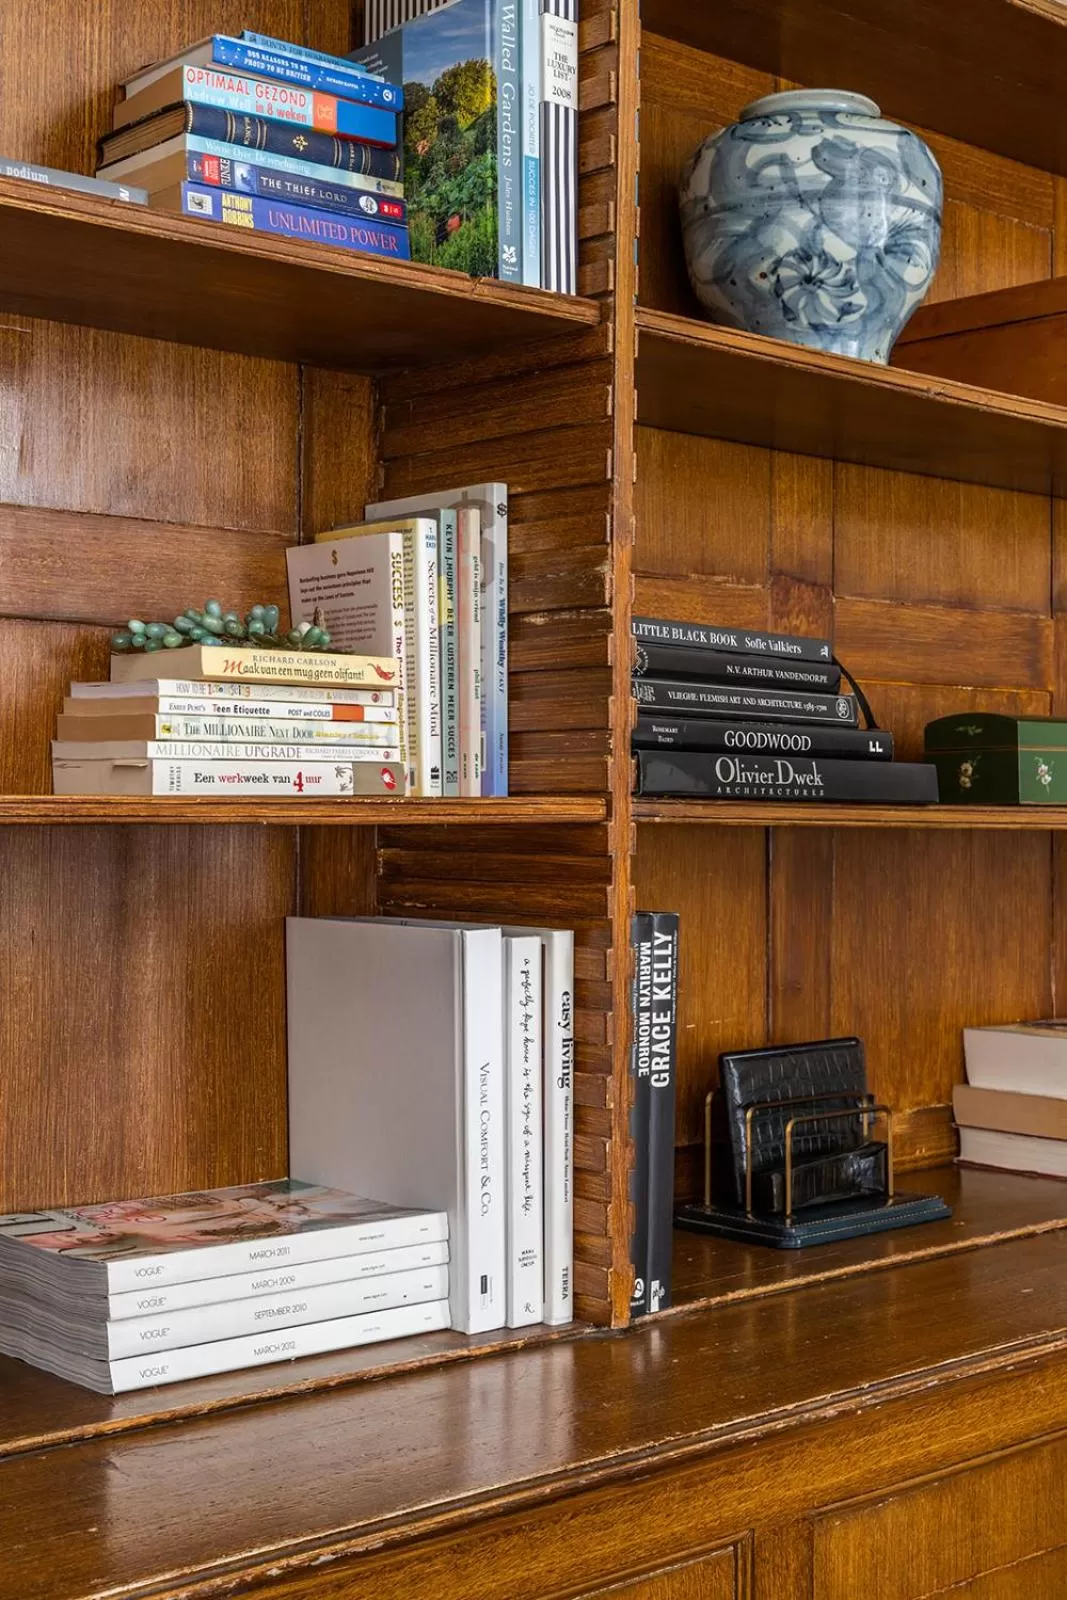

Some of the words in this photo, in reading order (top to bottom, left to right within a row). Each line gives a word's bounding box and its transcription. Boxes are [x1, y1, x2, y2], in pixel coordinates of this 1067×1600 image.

[501, 4, 516, 71] Walled
[547, 58, 576, 75] LUXURY
[554, 52, 568, 63] THE
[186, 68, 250, 95] OPTIMAAL
[255, 84, 307, 107] GEZOND
[286, 68, 312, 82] BRITISH
[187, 87, 226, 104] Andrew
[256, 103, 264, 113] in
[267, 103, 273, 115] 8
[277, 107, 307, 123] weken
[501, 82, 516, 167] Gardens
[6, 165, 49, 184] podium
[528, 160, 536, 196] SUCCES
[260, 176, 282, 190] THE
[284, 180, 316, 196] THIEF
[319, 189, 348, 203] LORD
[268, 210, 348, 241] UNLIMITED
[351, 227, 399, 253] POWER
[528, 210, 536, 224] 100
[528, 225, 536, 258] DAGEN
[445, 524, 453, 553] KEVIN
[391, 552, 403, 609] SUCCESS
[427, 561, 436, 605] Secrets
[446, 608, 454, 637] BETER
[497, 598, 506, 628] Wildly
[497, 630, 506, 668] Wealthy
[632, 622, 670, 638] LITTLE
[672, 628, 708, 643] BLACK
[710, 632, 738, 646] BOOK
[745, 636, 767, 651] Sofie
[769, 639, 802, 654] Valkiers
[223, 659, 260, 675] Maak
[260, 666, 278, 675] van
[278, 667, 293, 676] een
[294, 668, 314, 679] mug
[314, 668, 333, 680] geen
[334, 667, 364, 681] olifant!
[252, 655, 295, 665] RICHARD
[297, 658, 337, 667] CARLSON
[429, 627, 438, 697] Millionaire
[446, 642, 455, 690] LUISTEREN
[726, 665, 741, 674] N.V.
[742, 667, 774, 678] ARTHUR
[774, 670, 829, 683] VANDENDORPE
[212, 704, 231, 714] Teen
[233, 705, 271, 716] Etiquette
[288, 709, 302, 717] POST
[447, 695, 455, 721] MEER
[699, 693, 729, 703] FLEMISH
[729, 696, 742, 704] ART
[758, 698, 802, 709] ARCHITECTURE
[204, 723, 266, 737] MILLIONAIRE
[430, 703, 439, 737] Mind
[156, 744, 240, 757] MILLIONAIRE
[245, 745, 302, 759] UPGRADE
[447, 725, 456, 759] SUCCES
[724, 731, 811, 751] GOODWOOD
[869, 741, 883, 753] LL
[194, 773, 215, 784] Een
[217, 773, 269, 784] werkweek
[272, 776, 291, 784] van
[293, 771, 304, 792] 4
[305, 776, 322, 784] uur
[715, 756, 774, 784] Olivier
[774, 760, 825, 786] Dwek
[716, 787, 825, 797] ARCHITECTURES
[639, 942, 651, 1007] MARILYN
[651, 931, 672, 1000] KELLY
[557, 991, 571, 1031] easy
[523, 1036, 535, 1063] house
[638, 1012, 650, 1077] MONROE
[650, 1011, 671, 1088] GRACE
[557, 1037, 573, 1089] living
[480, 1062, 491, 1106] VISUAL
[480, 1110, 491, 1171] COMFORT
[480, 1175, 491, 1189] &
[249, 1249, 275, 1260] MARCH
[277, 1247, 291, 1256] 2011
[251, 1279, 277, 1290] MARCH
[279, 1276, 295, 1286] 2009
[561, 1266, 569, 1300] TERRA
[254, 1306, 291, 1320] SEPTEMBER
[292, 1303, 307, 1313] 2010
[254, 1345, 277, 1356] MARCH
[279, 1341, 296, 1351] 2012
